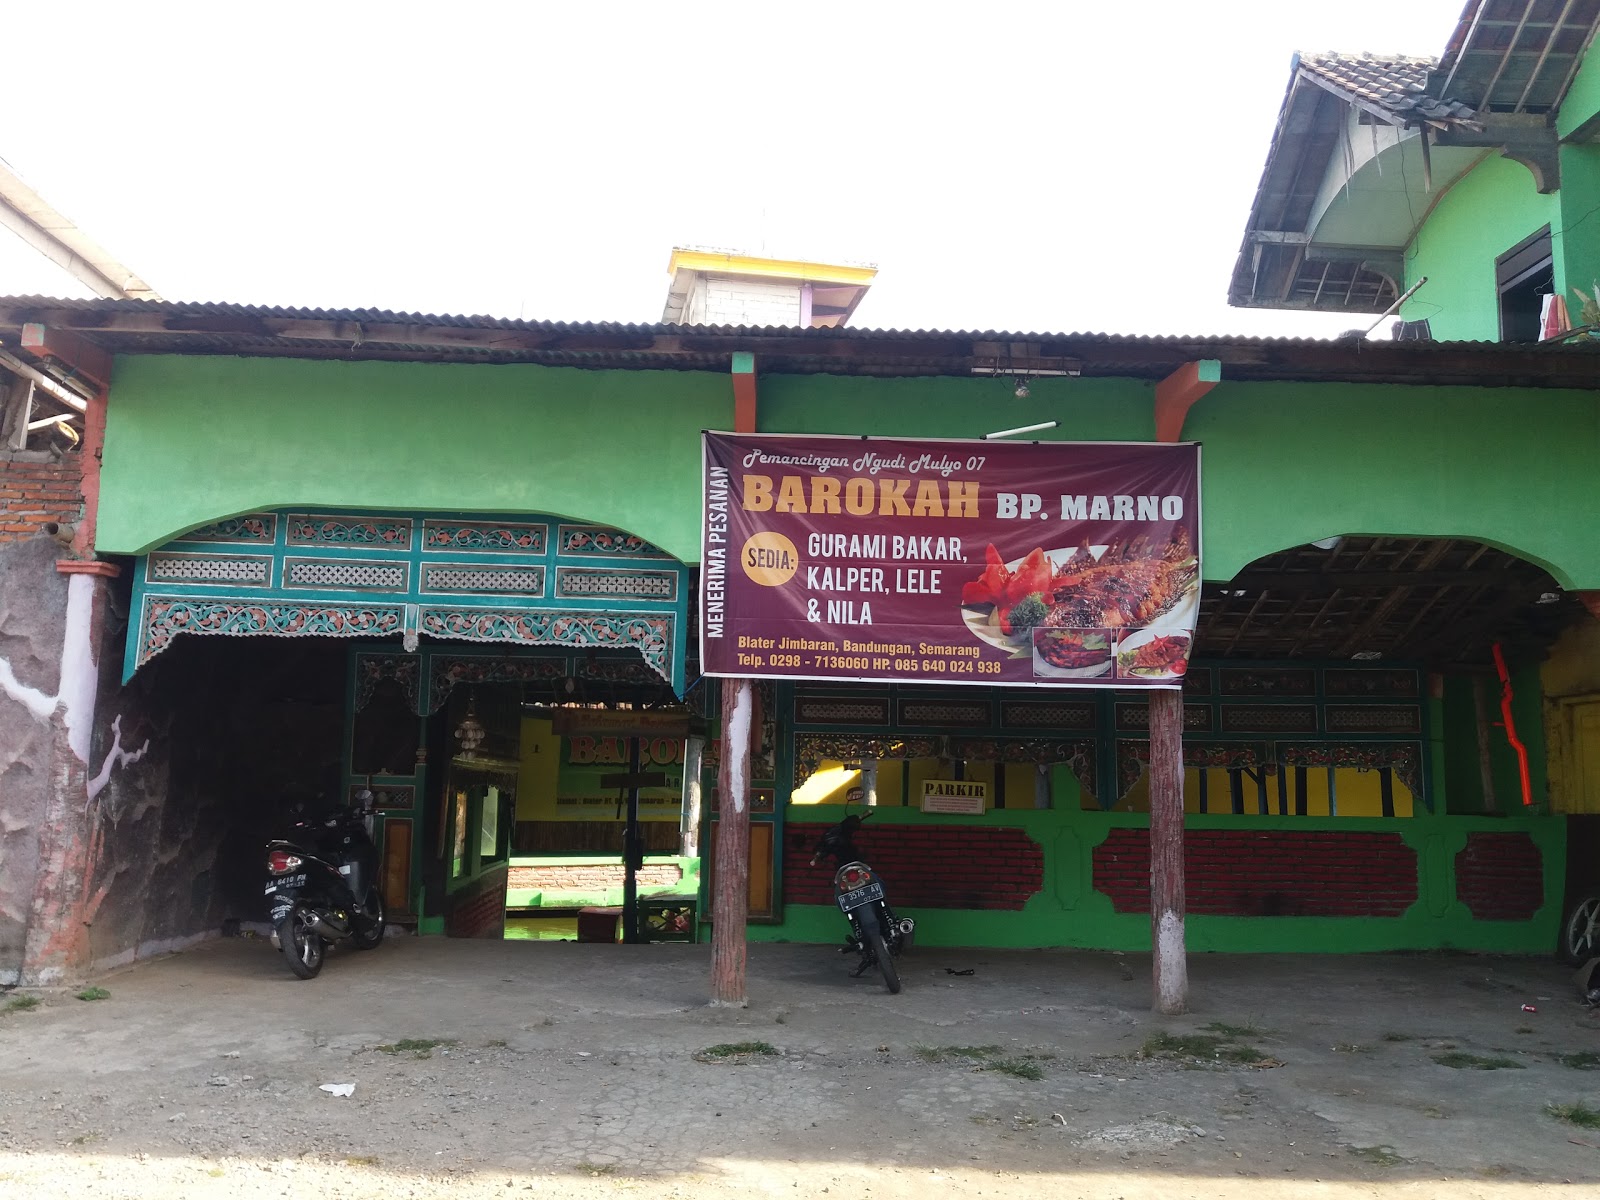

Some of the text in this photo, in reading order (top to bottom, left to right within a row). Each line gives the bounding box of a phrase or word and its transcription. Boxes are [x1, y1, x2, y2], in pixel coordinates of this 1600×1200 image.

[743, 448, 986, 477] Pemancingan Ngudi Mulyo 07
[742, 474, 980, 518] BAROKAH
[996, 492, 1183, 521] BP. MARNO
[707, 466, 728, 638] MENERIMA PESANAN
[747, 547, 794, 570] SEDIA:
[808, 532, 967, 563] GURAMI BAKAR,
[807, 566, 942, 595] KALPER, LELE
[806, 598, 873, 625] & NILA
[738, 636, 980, 658] Blater Jimbaran, Bandungan, Semarang
[737, 653, 765, 669] Telp.
[769, 654, 801, 667] 0298
[814, 655, 869, 669] 7136060
[872, 657, 891, 670] HP.
[894, 658, 918, 671] 085
[922, 659, 946, 672] 640
[949, 660, 973, 673] 024
[977, 661, 1001, 674] 938
[925, 783, 984, 797] PARKIR
